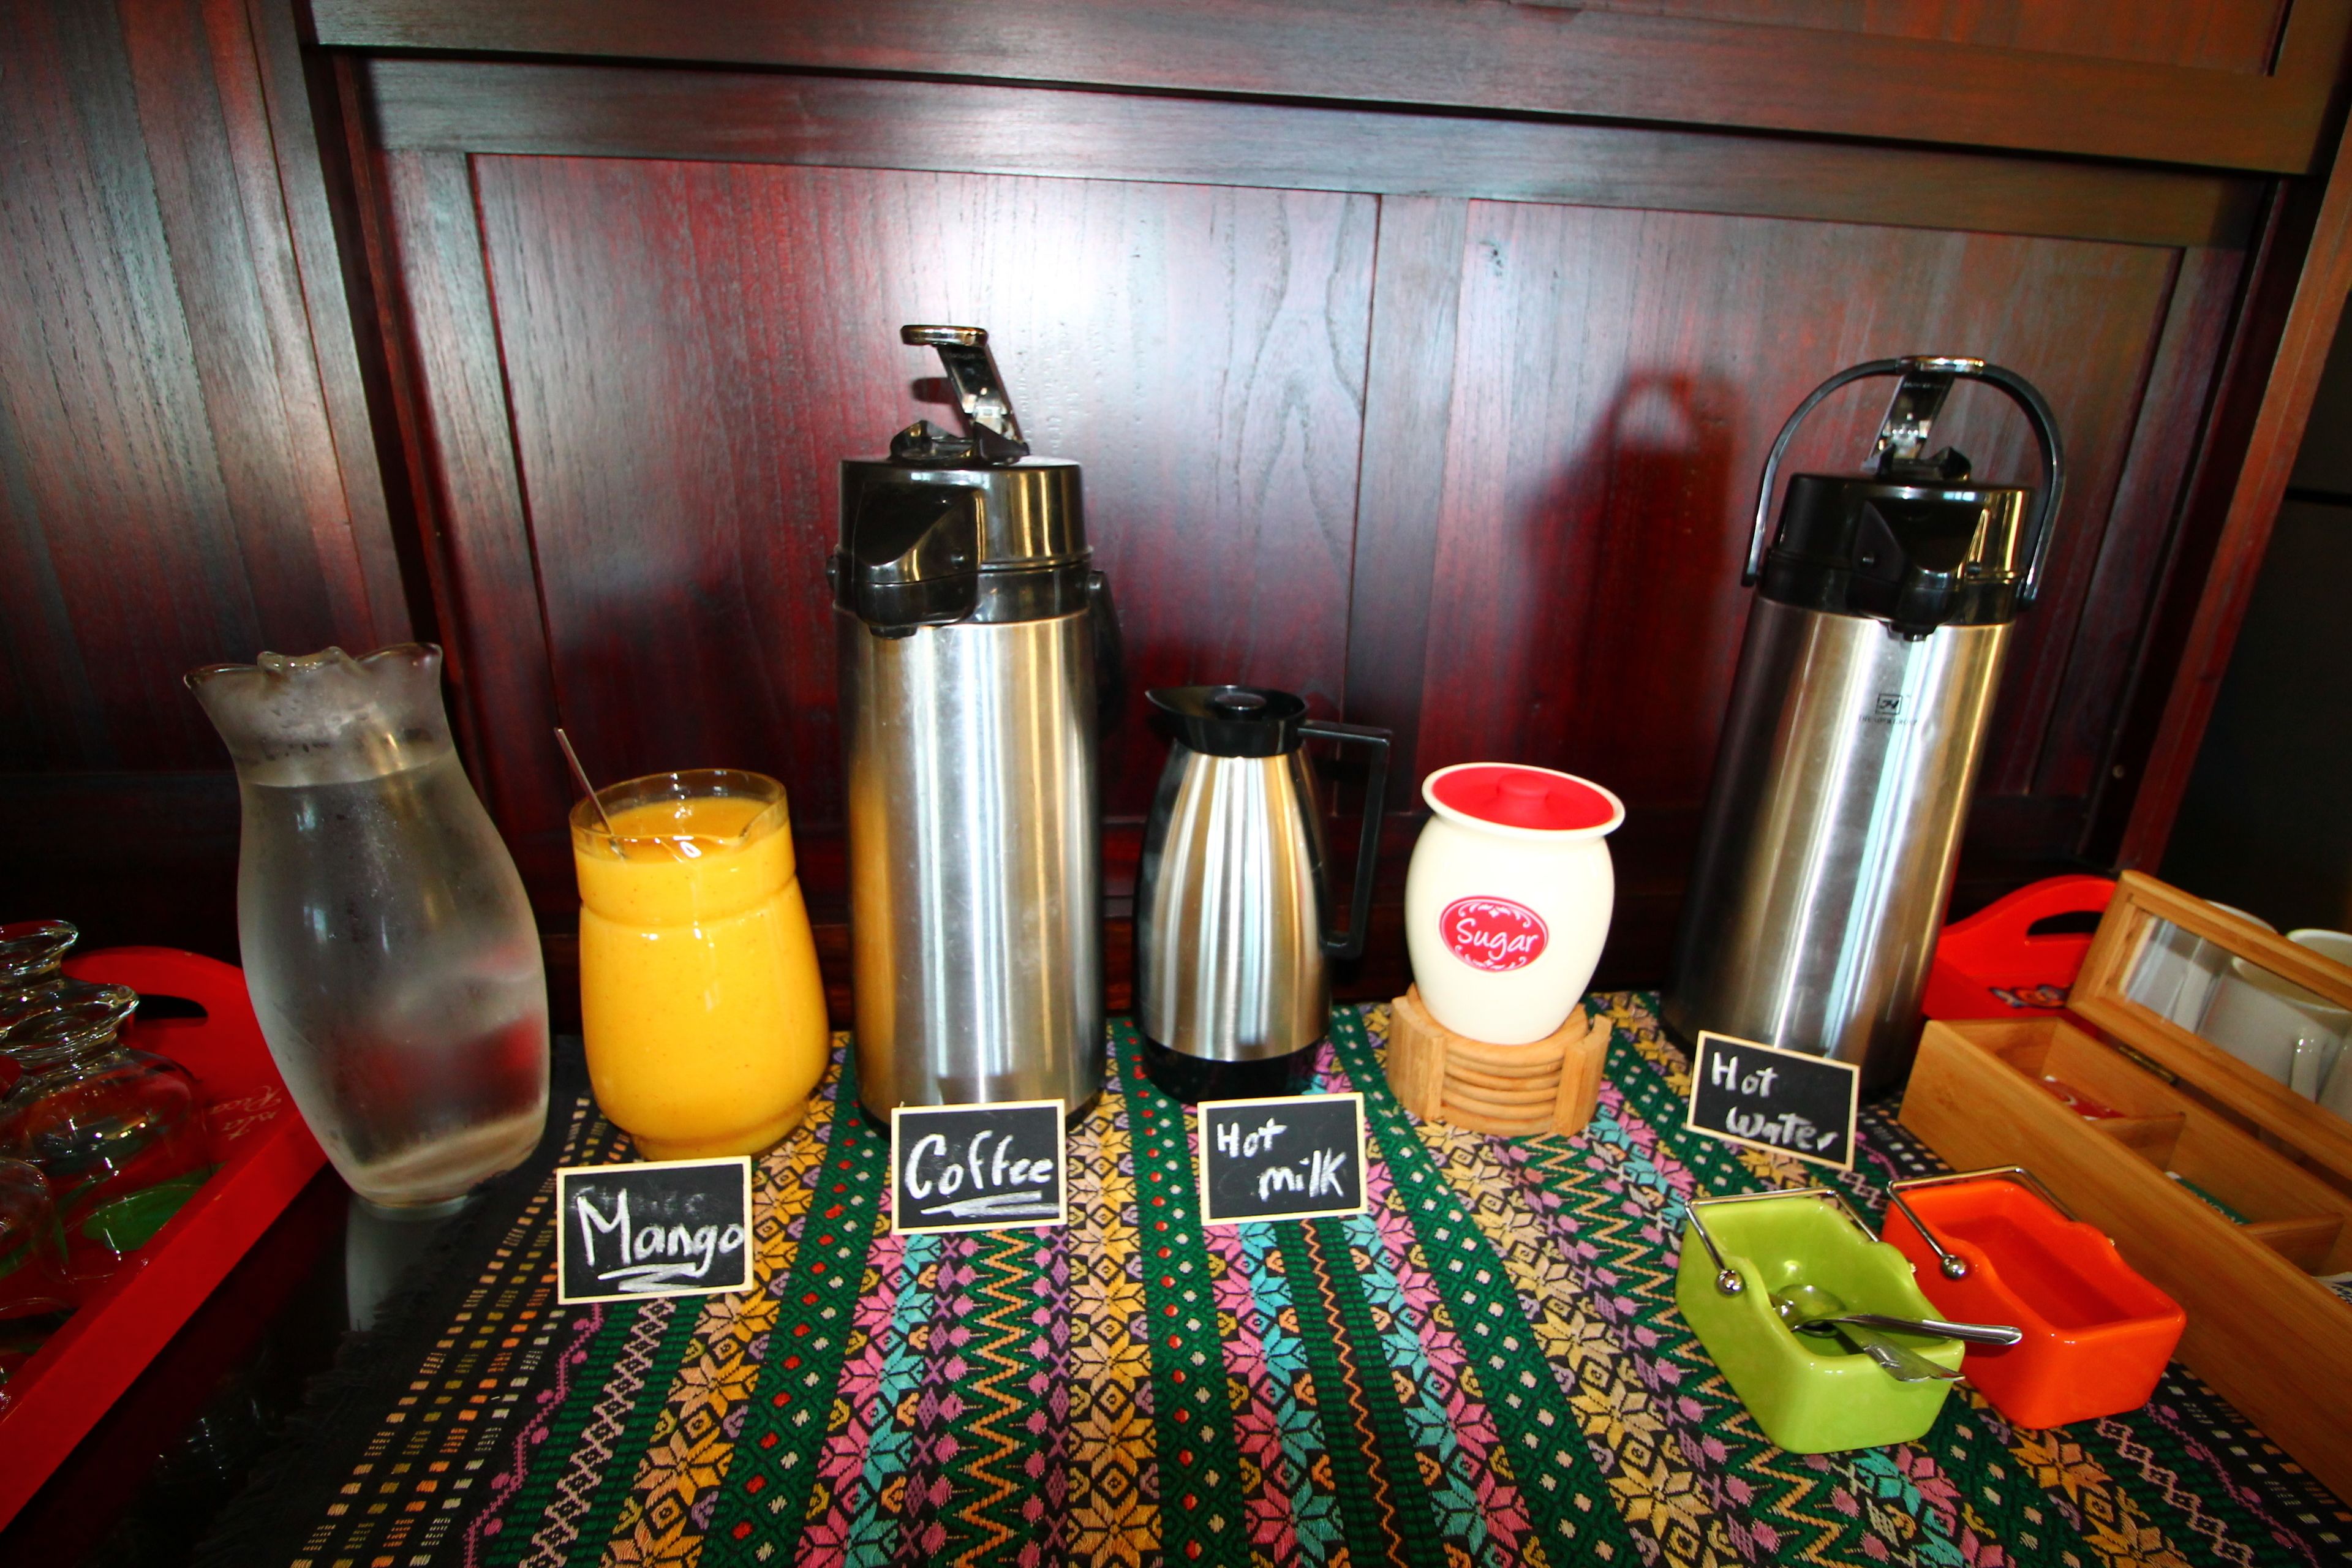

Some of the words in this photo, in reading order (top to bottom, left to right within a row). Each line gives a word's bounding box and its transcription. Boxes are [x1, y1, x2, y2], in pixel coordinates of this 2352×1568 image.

[1456, 918, 1539, 961] Sugar
[1711, 1052, 1779, 1098] Hot
[1216, 1117, 1287, 1158] Hot
[905, 1129, 1054, 1199] Coffee
[577, 1188, 745, 1278] Mango
